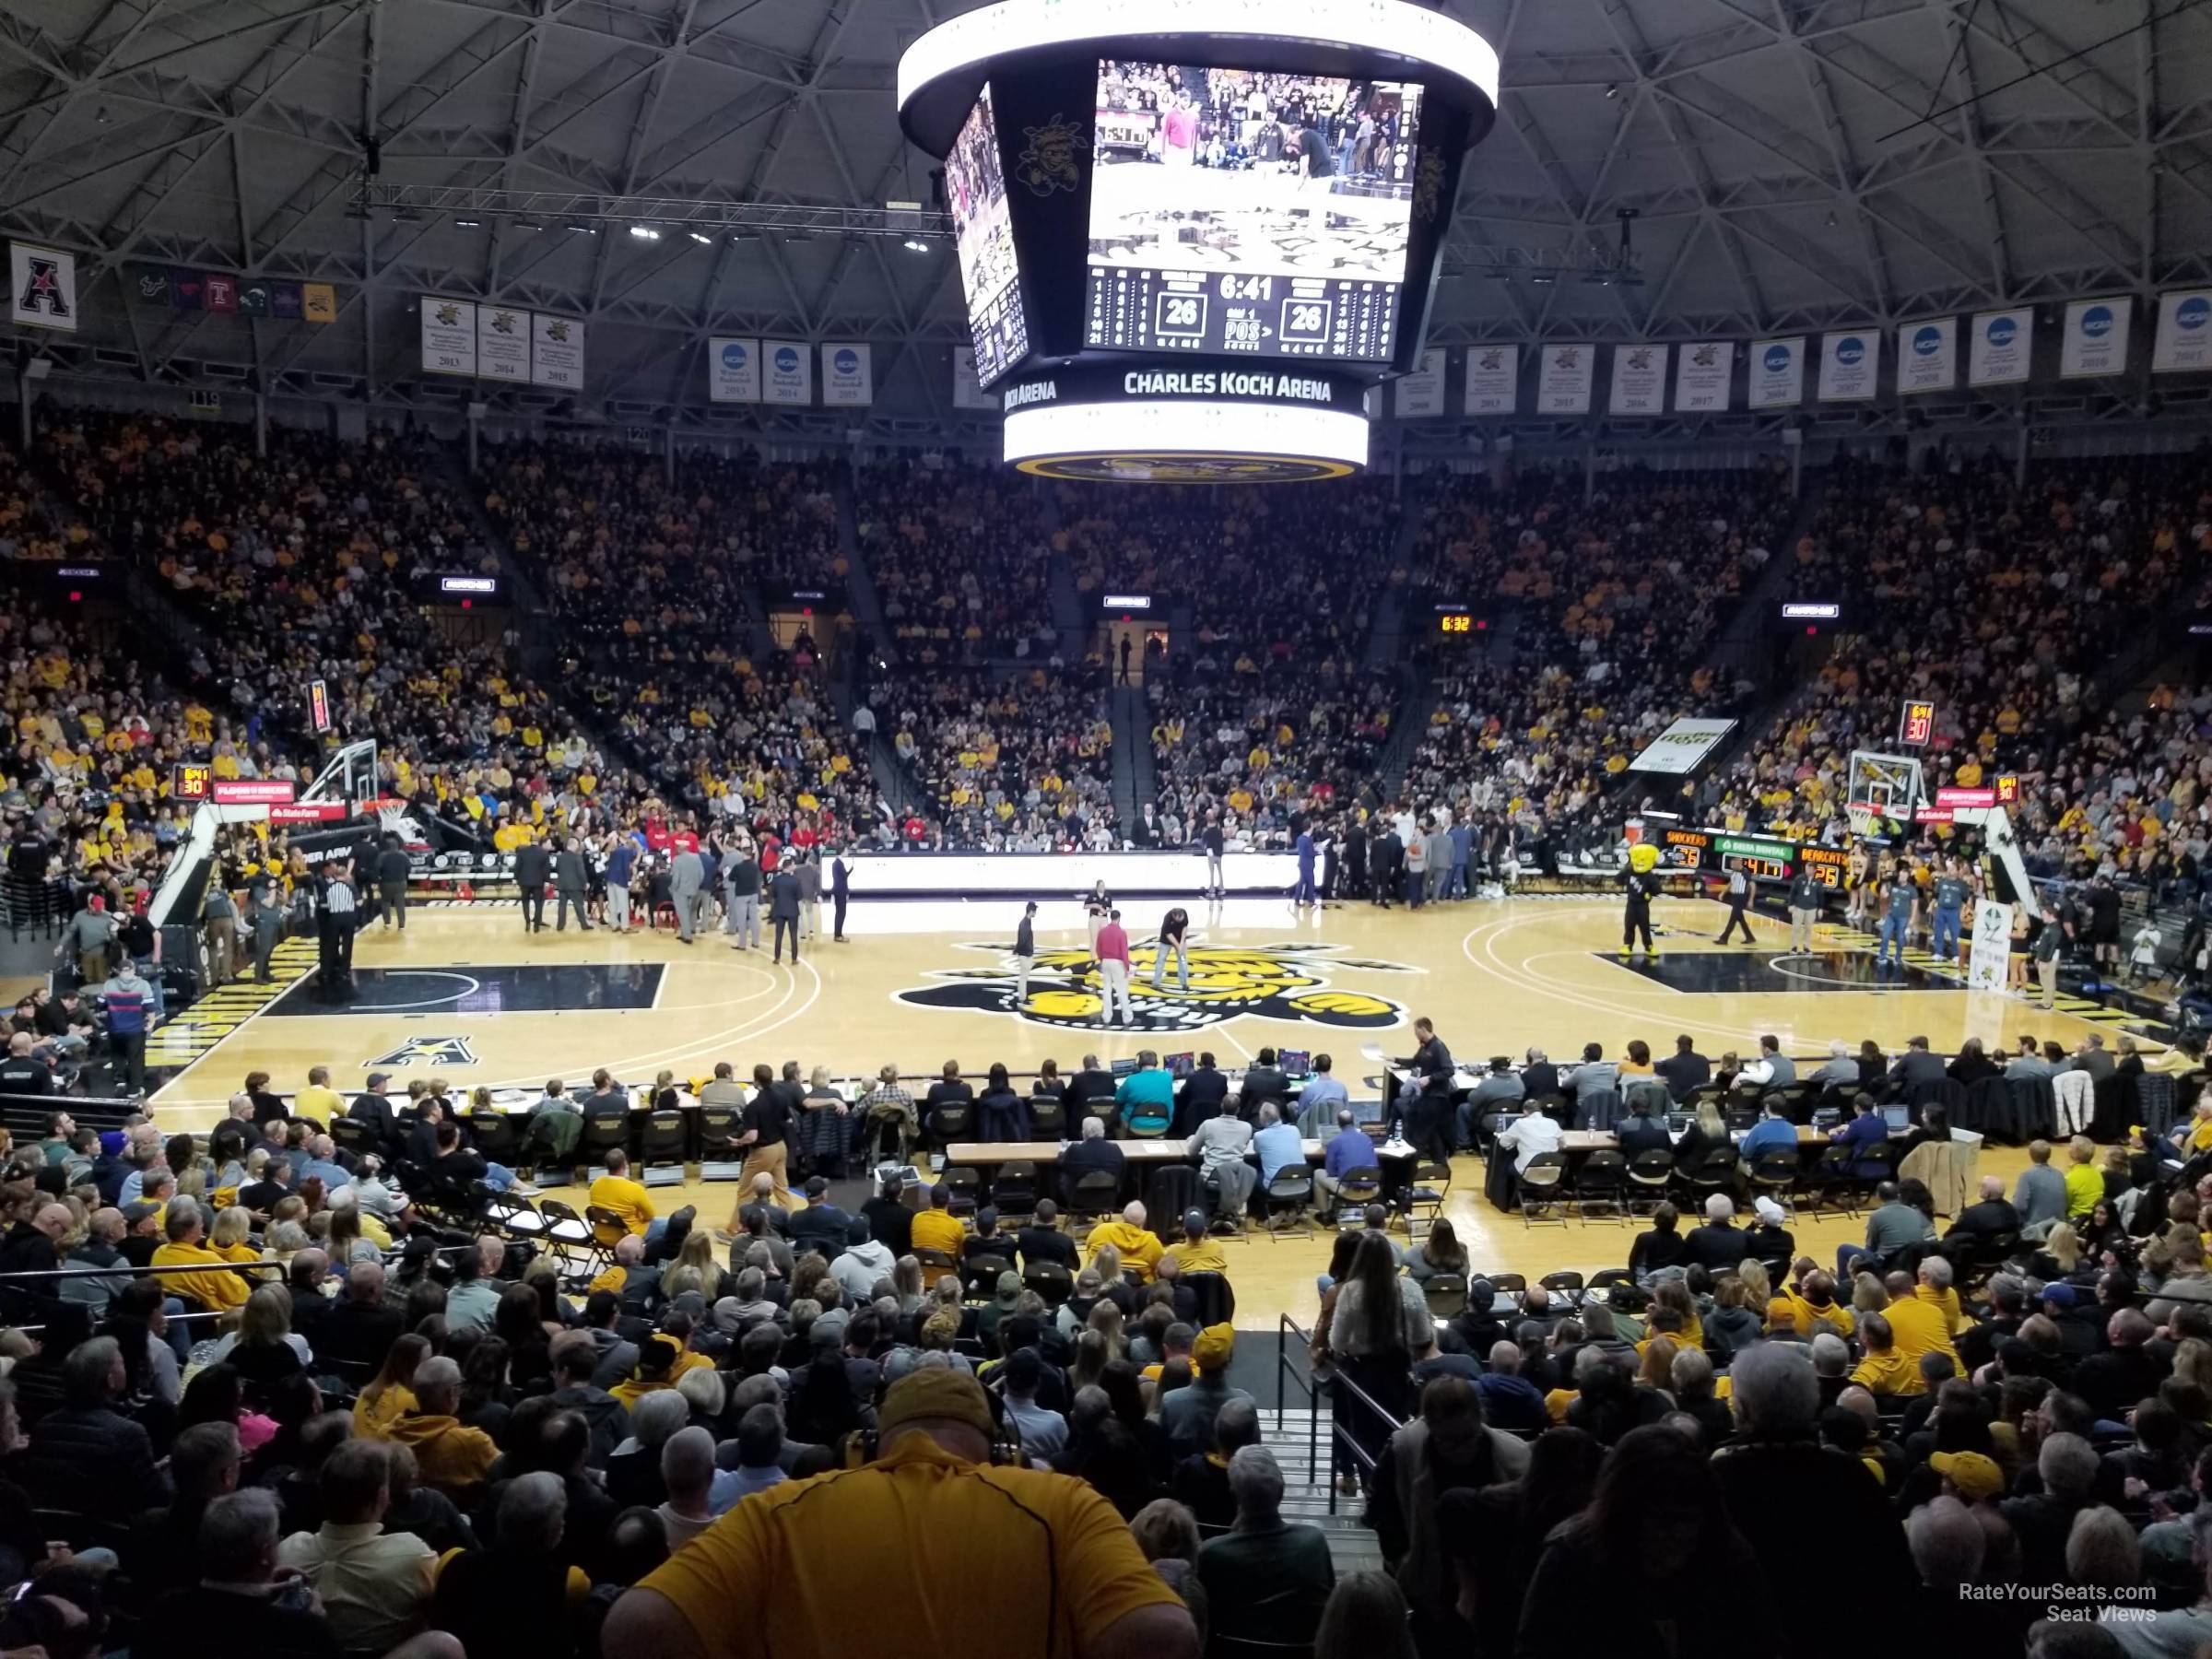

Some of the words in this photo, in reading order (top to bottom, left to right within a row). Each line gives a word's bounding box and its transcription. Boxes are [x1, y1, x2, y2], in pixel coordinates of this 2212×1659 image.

[1095, 280, 1102, 291] 1
[1141, 283, 1148, 294] 1
[1219, 274, 1272, 301] 6:41
[1094, 293, 1102, 305] 2
[1140, 296, 1147, 307] 1
[1362, 294, 1371, 305] 4
[1385, 296, 1393, 307] 1
[1139, 309, 1147, 320] 1
[1165, 299, 1198, 325] 26
[1290, 305, 1322, 332] 26
[1384, 308, 1392, 319] 1
[1225, 321, 1260, 341] POS
[1138, 335, 1145, 346] 1
[1357, 345, 1366, 356] 4
[1380, 346, 1386, 357] 1
[1018, 381, 1057, 405] ARENA
[1124, 371, 1216, 394] CHARLES
[1220, 372, 1274, 395] KOCH
[1276, 375, 1331, 402] ARENA
[1442, 617, 1469, 631] 6:32
[1908, 719, 1928, 740] 30
[184, 781, 203, 794] 30
[1998, 787, 2013, 800] 30
[1666, 830, 1707, 847] SHOCKERS
[1801, 848, 1849, 865] BEARCATS
[1815, 865, 1837, 886] 26
